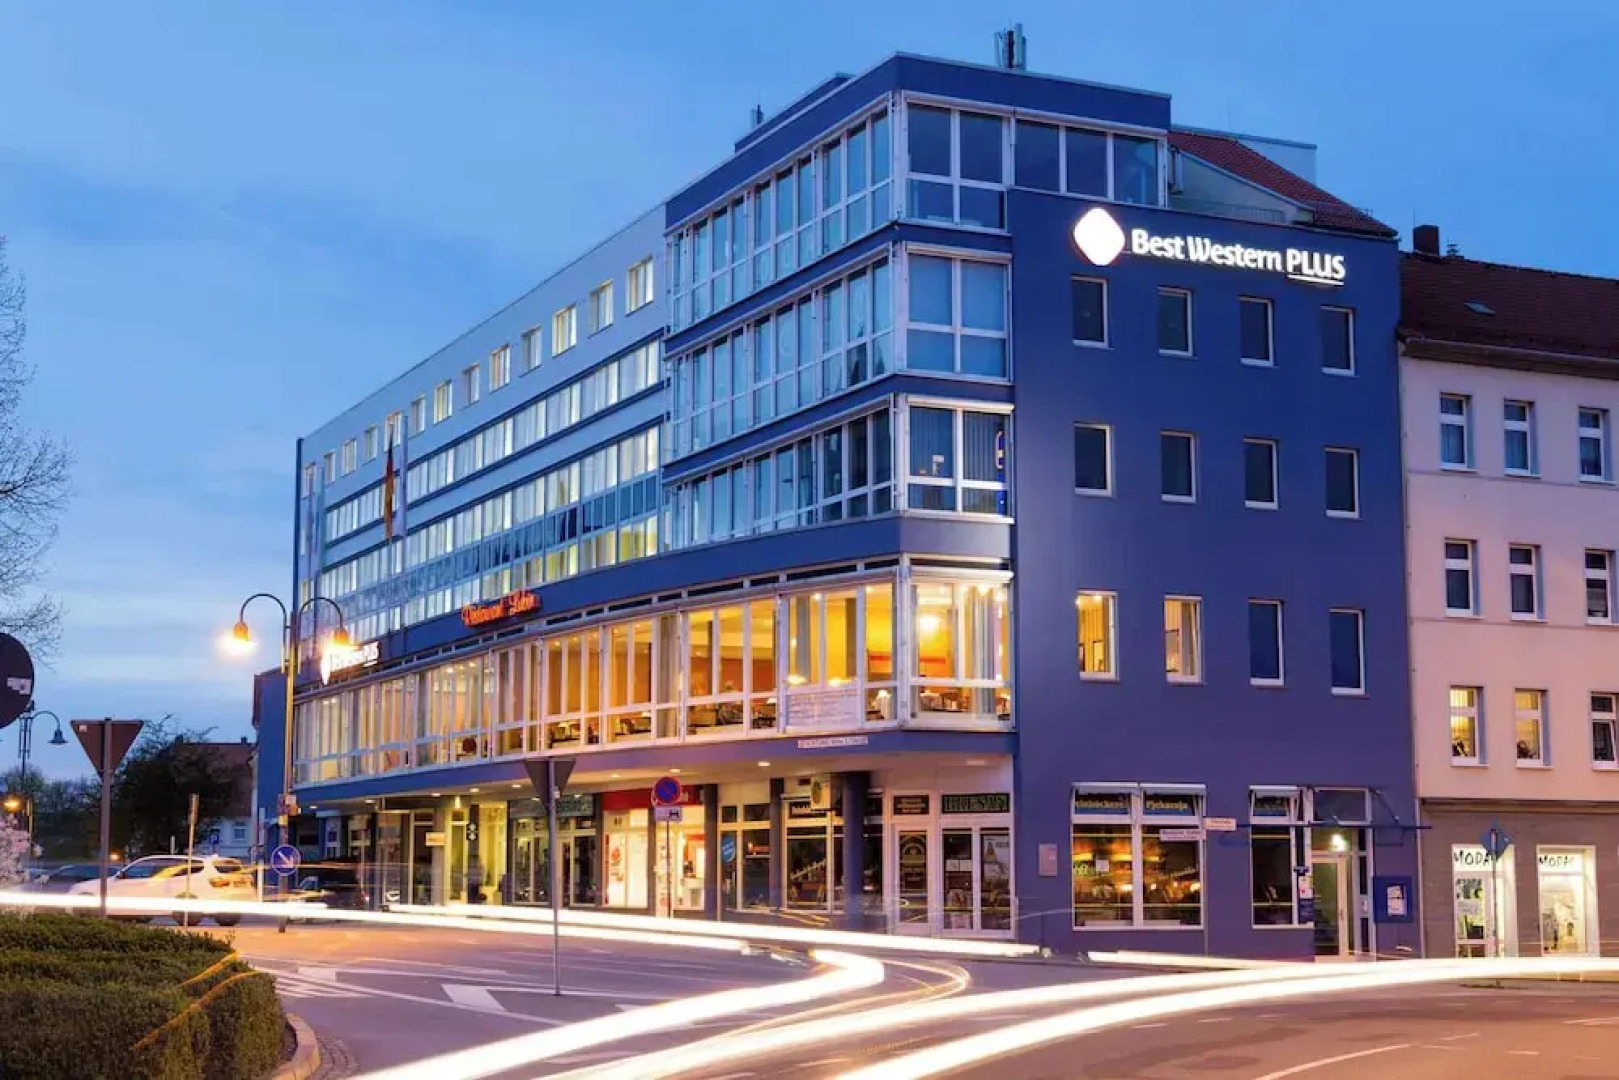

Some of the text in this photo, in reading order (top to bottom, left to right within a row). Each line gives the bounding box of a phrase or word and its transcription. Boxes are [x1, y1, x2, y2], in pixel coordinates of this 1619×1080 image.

[1131, 228, 1346, 280] Best Western PLUS
